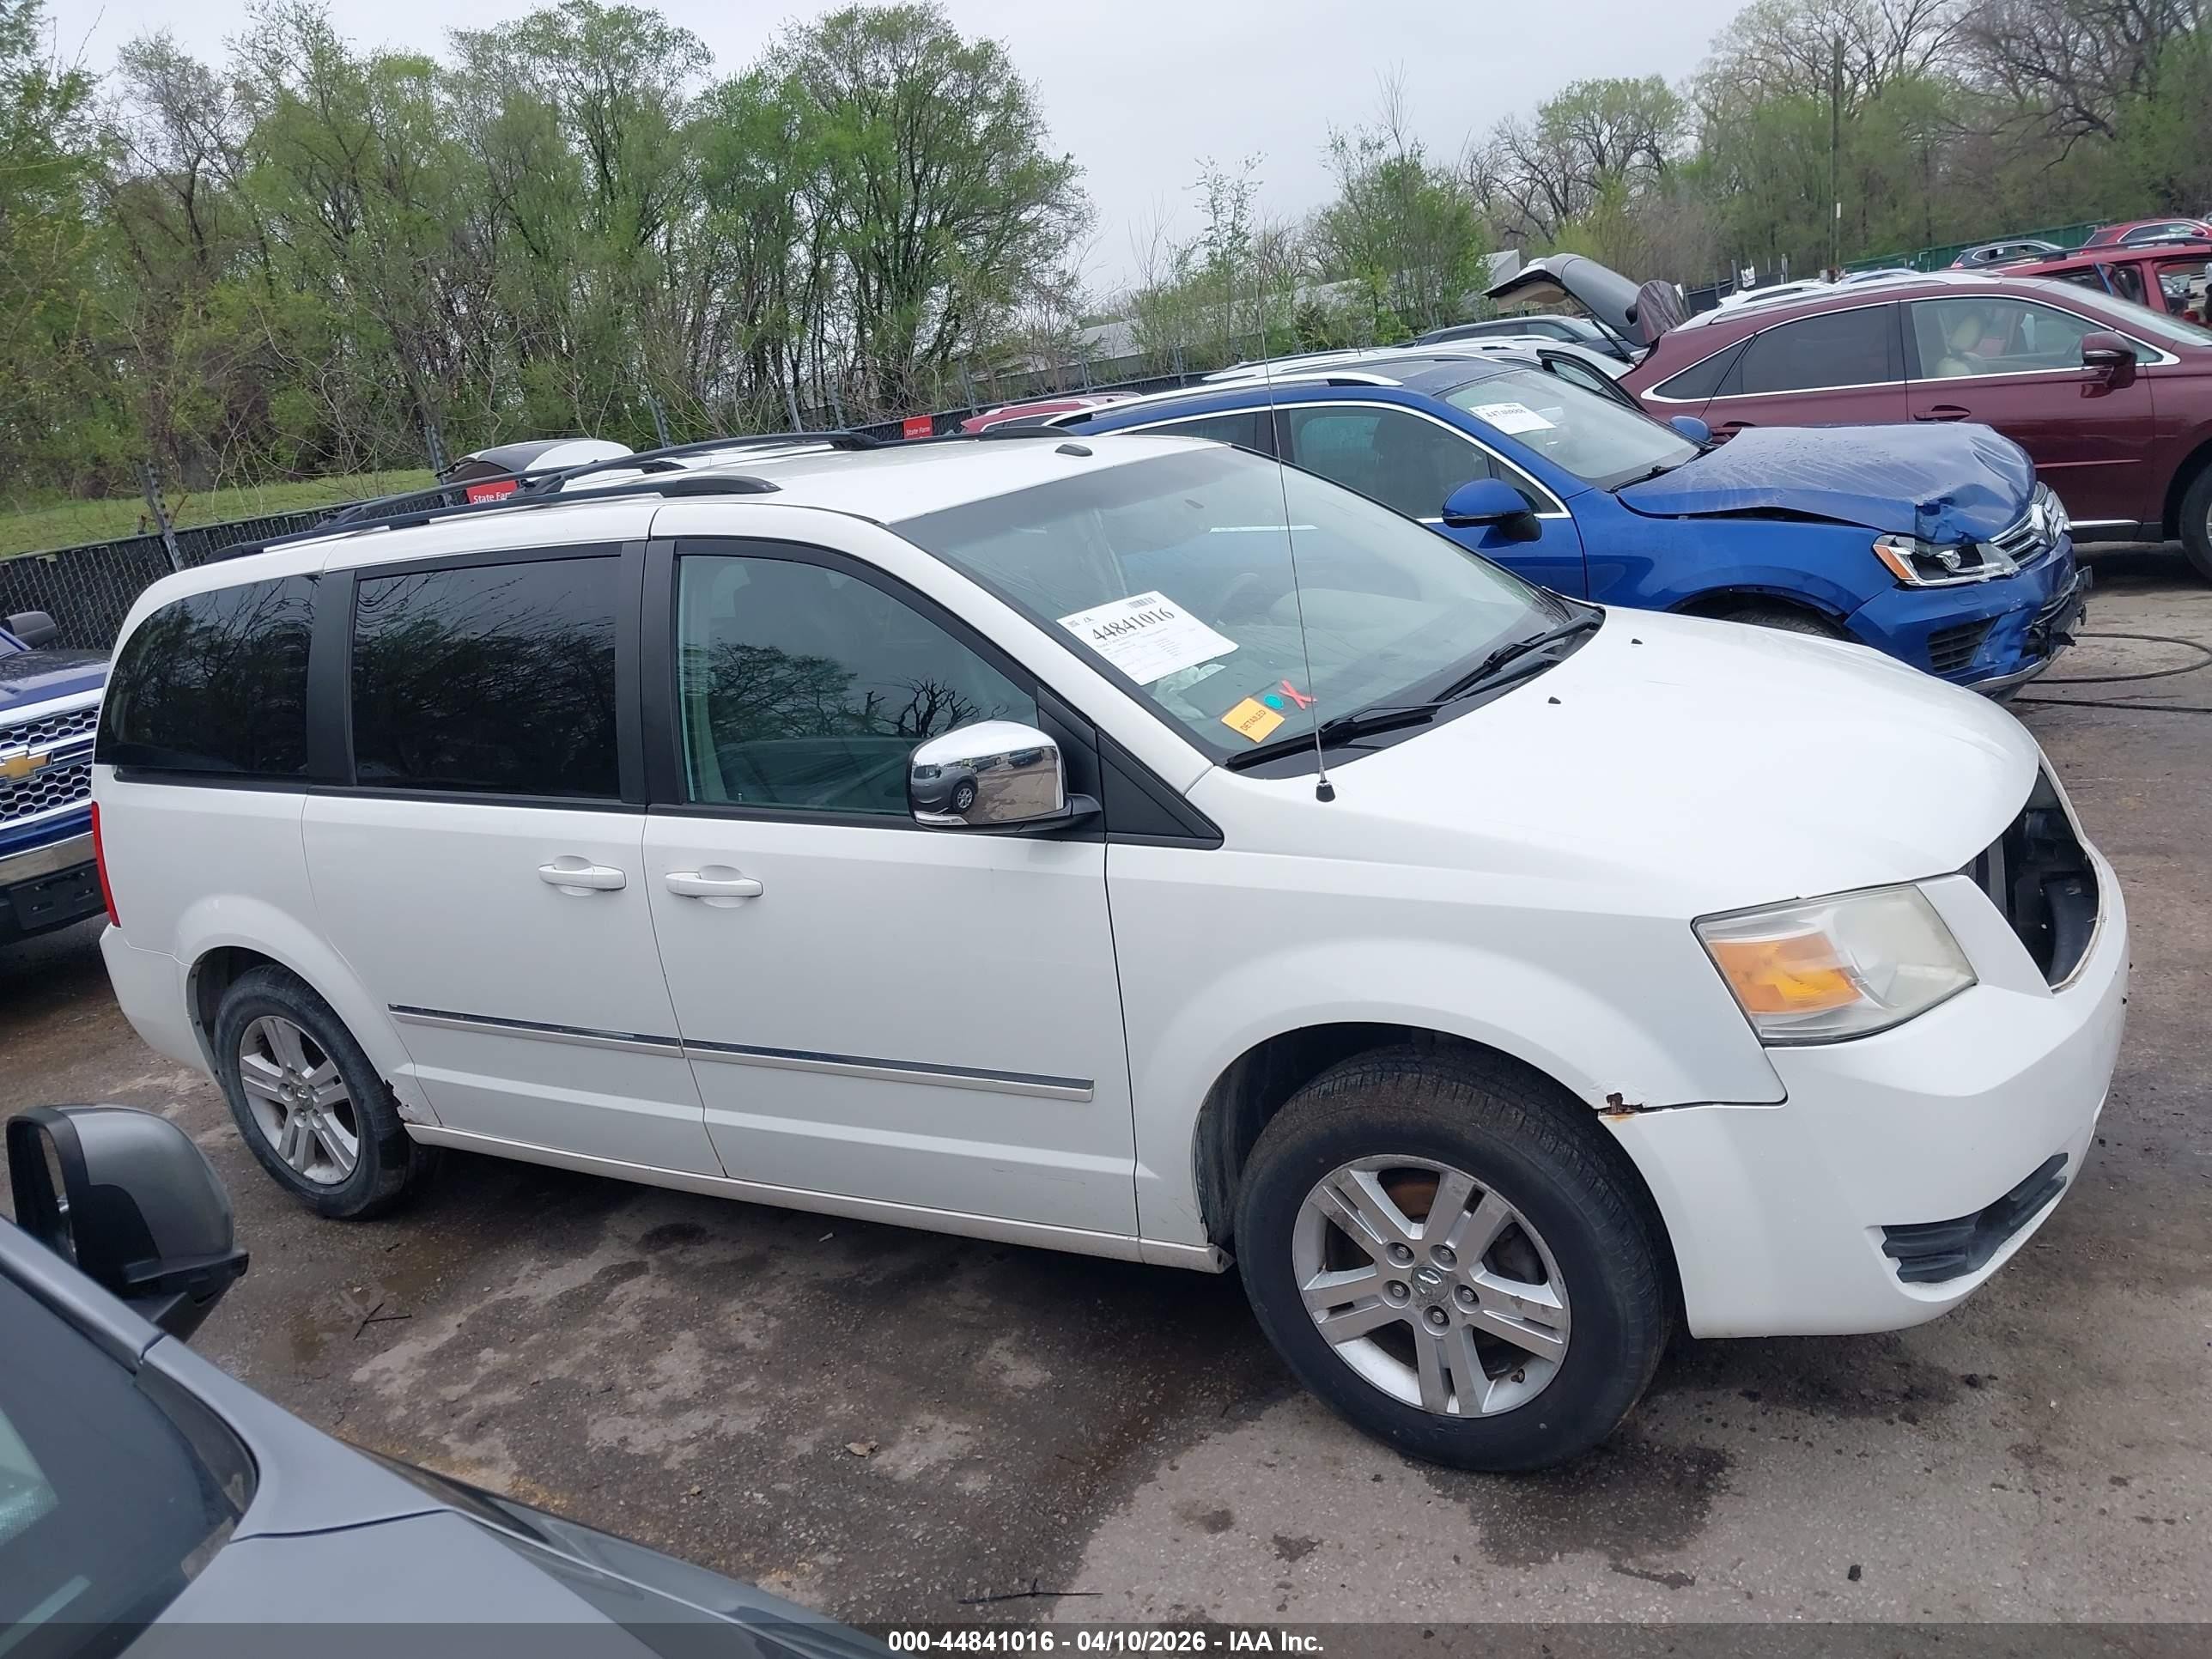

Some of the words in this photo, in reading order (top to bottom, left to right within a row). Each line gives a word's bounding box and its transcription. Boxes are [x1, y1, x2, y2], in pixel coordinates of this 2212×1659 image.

[473, 494, 495, 504] State
[1092, 607, 1176, 641] 44841016
[1240, 709, 1267, 732] DETAILED
